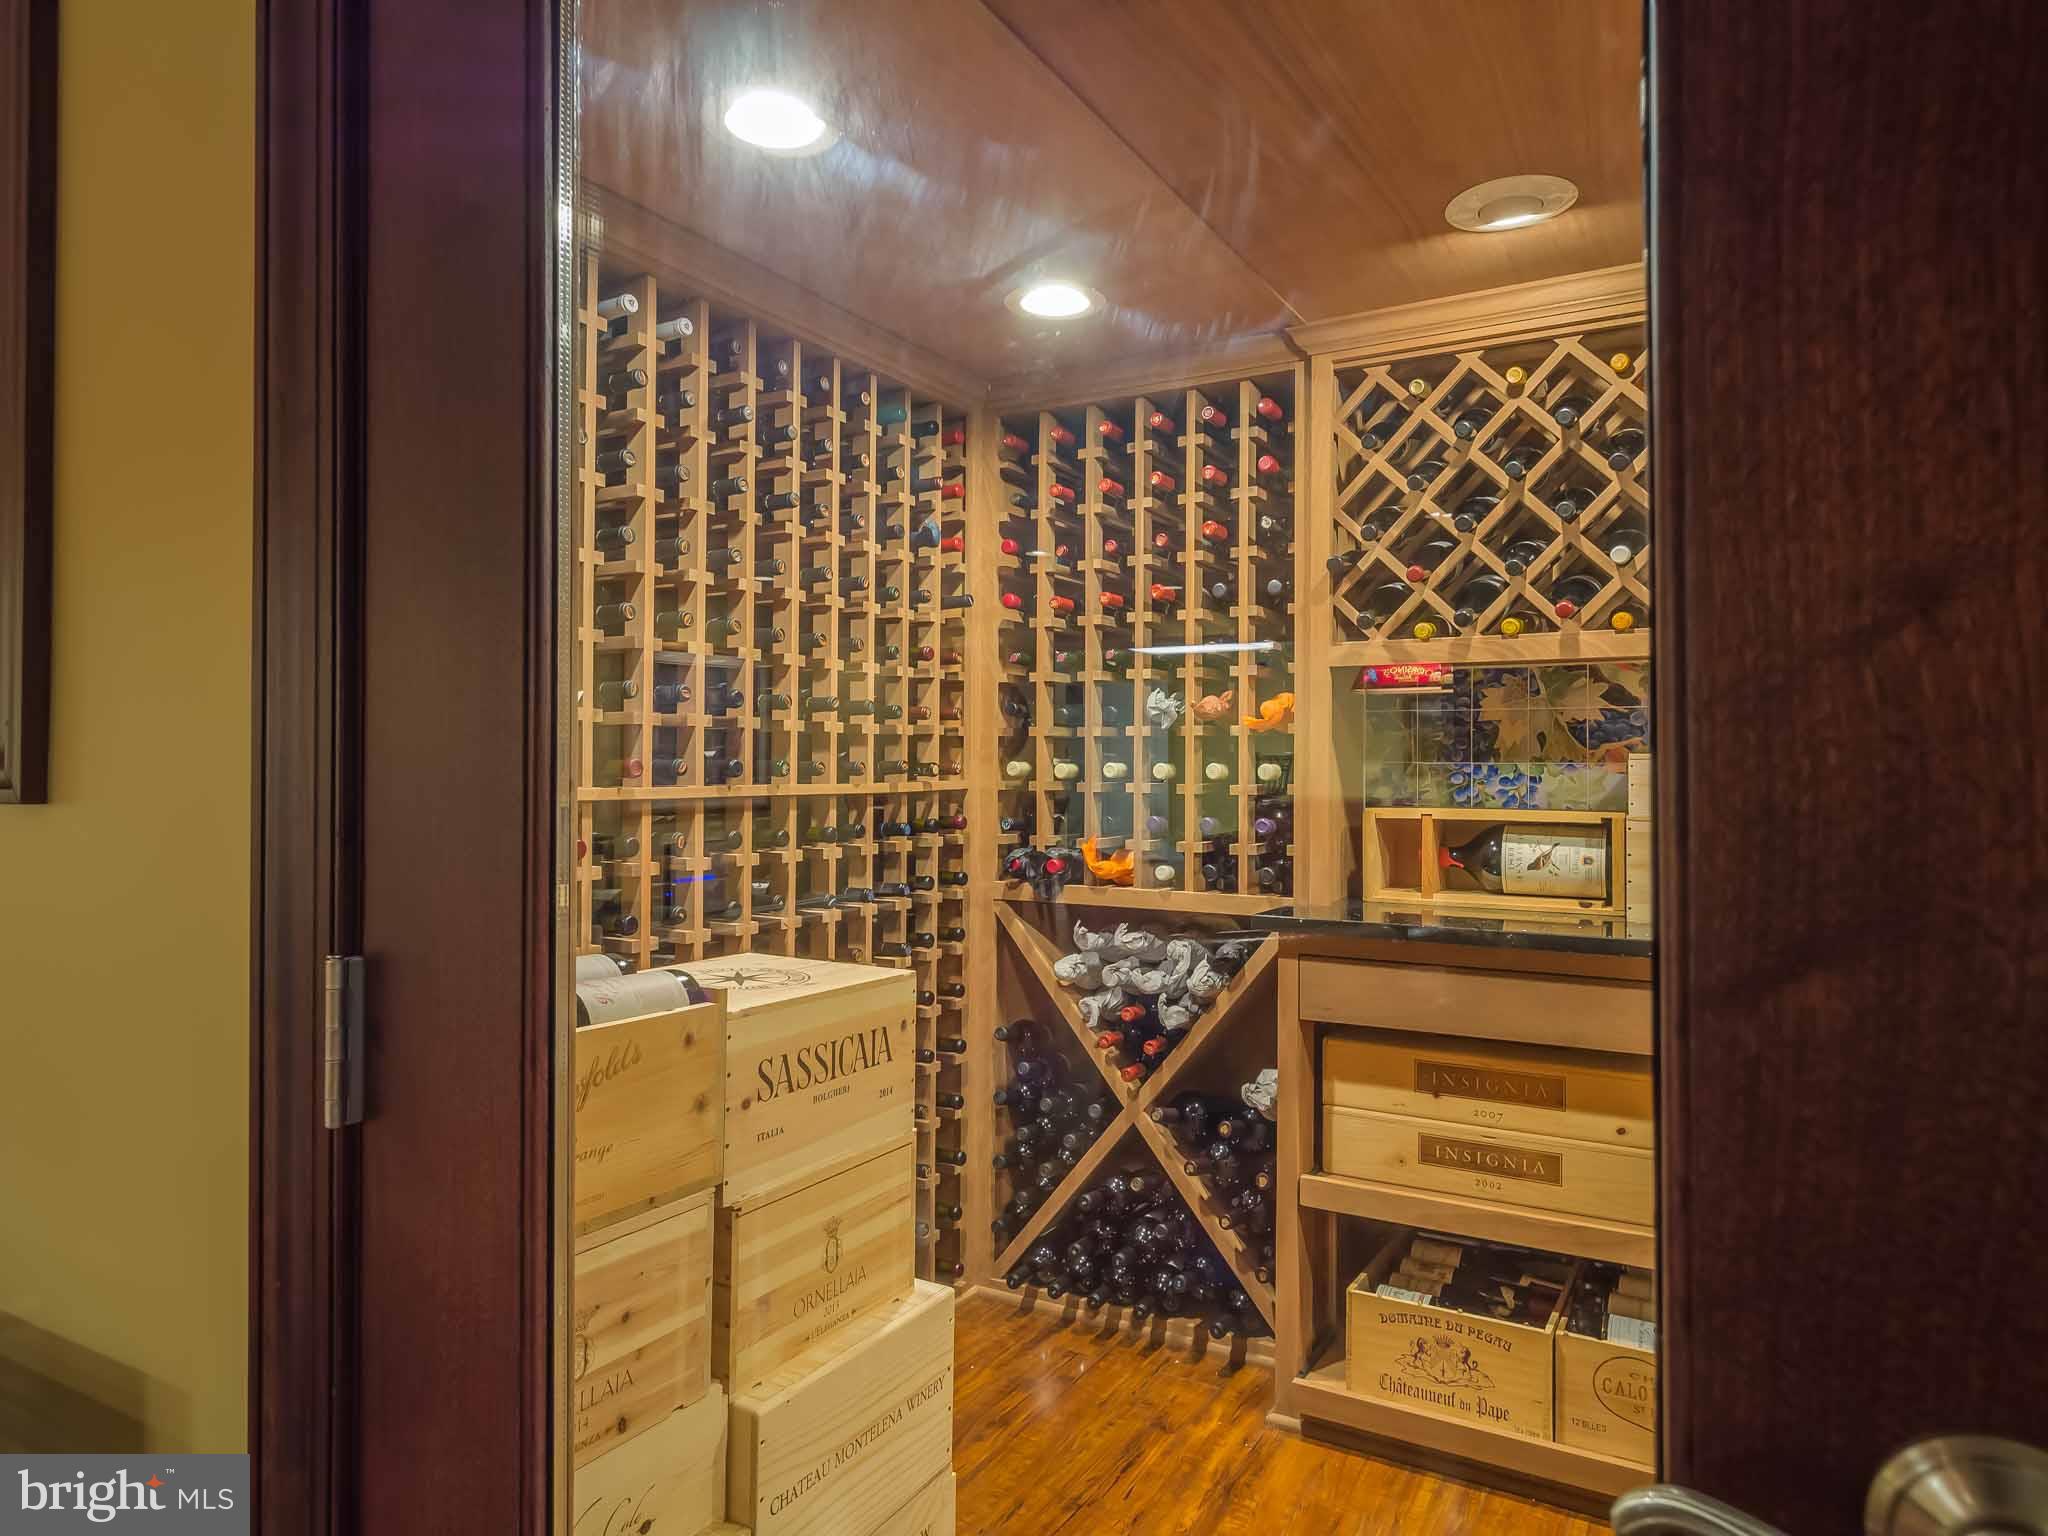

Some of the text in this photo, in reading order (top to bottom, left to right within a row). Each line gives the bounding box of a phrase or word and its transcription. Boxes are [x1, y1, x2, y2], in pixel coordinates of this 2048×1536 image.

[576, 1039, 643, 1113] folds
[756, 1026, 894, 1103] SASSICAIA
[813, 1085, 851, 1104] BOLGHERI
[879, 1086, 893, 1099] 2014
[1431, 1070, 1549, 1099] INSIGNIA
[1472, 1109, 1504, 1122] 2007
[756, 1127, 784, 1143] ITALIA
[1432, 1144, 1546, 1176] INSIGNIA
[1474, 1178, 1503, 1191] 2002
[793, 1264, 867, 1319] ORNELLAIA
[1379, 1313, 1513, 1352] DOMAINE DU PEGAU
[580, 1368, 633, 1412] LLAIA
[1602, 1377, 1649, 1402] CALO
[1476, 1396, 1511, 1422] Pape
[769, 1375, 946, 1516] CHATEAU MONTELENA WINERY
